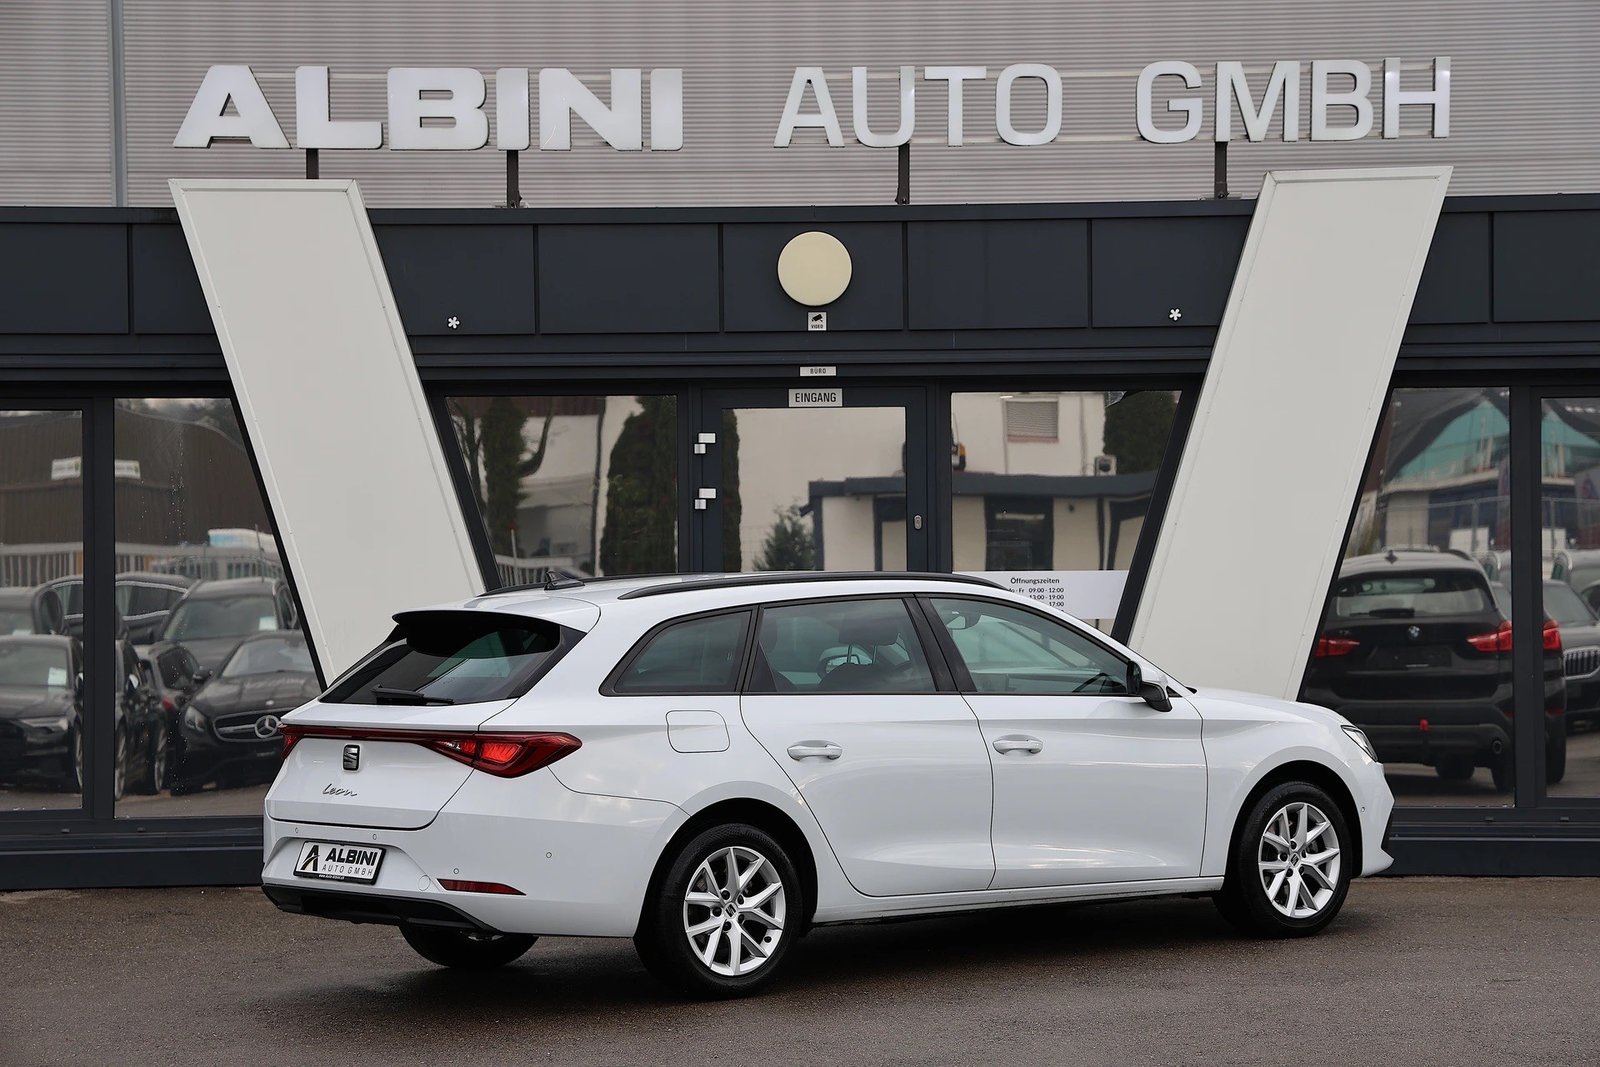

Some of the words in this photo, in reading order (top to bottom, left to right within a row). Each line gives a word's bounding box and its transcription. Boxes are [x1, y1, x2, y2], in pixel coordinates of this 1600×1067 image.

[173, 65, 684, 151] ALBINI
[774, 63, 1064, 148] AUTO
[1135, 56, 1452, 144] GMBH
[795, 392, 837, 403] EINGANG
[1010, 577, 1060, 585] Öffnungszeiten
[325, 848, 378, 866] ALBINI
[322, 864, 345, 874] AUTO
[347, 866, 374, 876] GMBH
